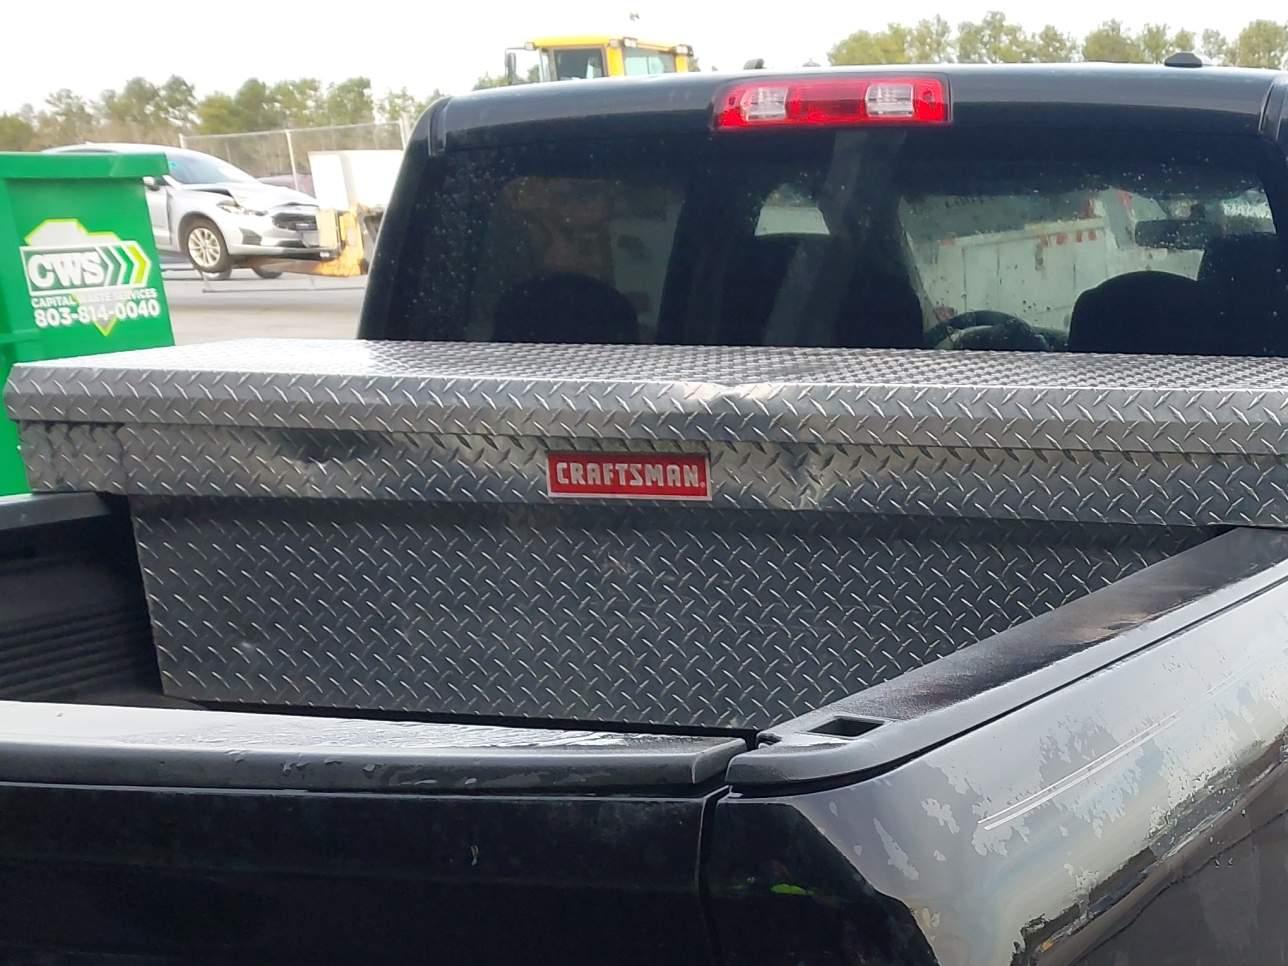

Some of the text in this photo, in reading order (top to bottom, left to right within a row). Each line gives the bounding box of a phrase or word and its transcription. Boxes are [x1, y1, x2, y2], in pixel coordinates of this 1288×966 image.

[28, 251, 105, 288] CWS
[31, 295, 77, 308] CAPITAL
[33, 299, 160, 328] 803-814-0040
[556, 462, 699, 488] CRAFTSMAN
